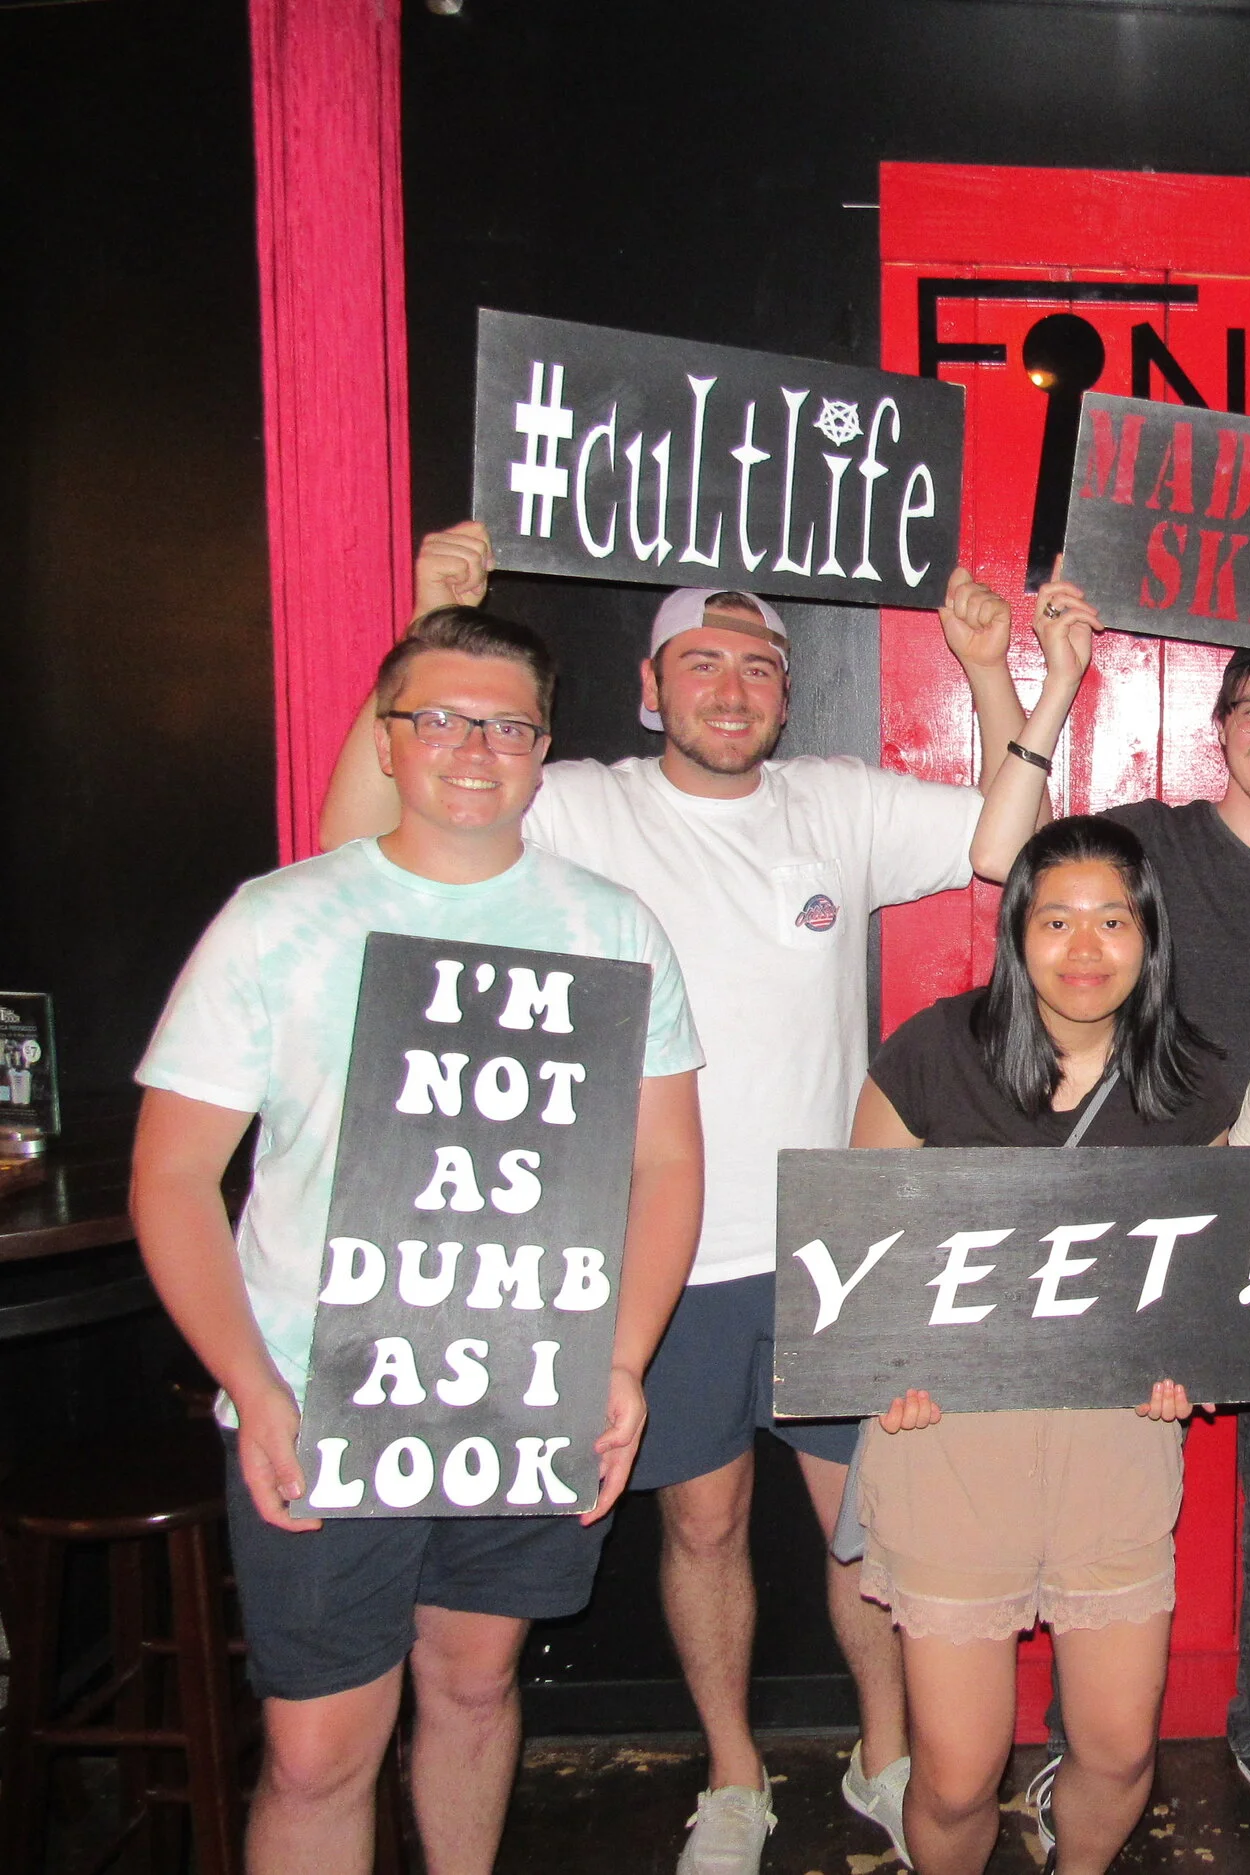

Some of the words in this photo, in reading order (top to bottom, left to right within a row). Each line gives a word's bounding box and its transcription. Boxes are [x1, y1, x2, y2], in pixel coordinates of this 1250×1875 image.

[425, 960, 574, 1033] I'M
[395, 1050, 585, 1124] NOT
[414, 1146, 541, 1214] AS
[319, 1237, 610, 1311] DUMB
[353, 1336, 489, 1406] AS
[523, 1340, 560, 1406] I
[309, 1437, 578, 1508] LOOK
